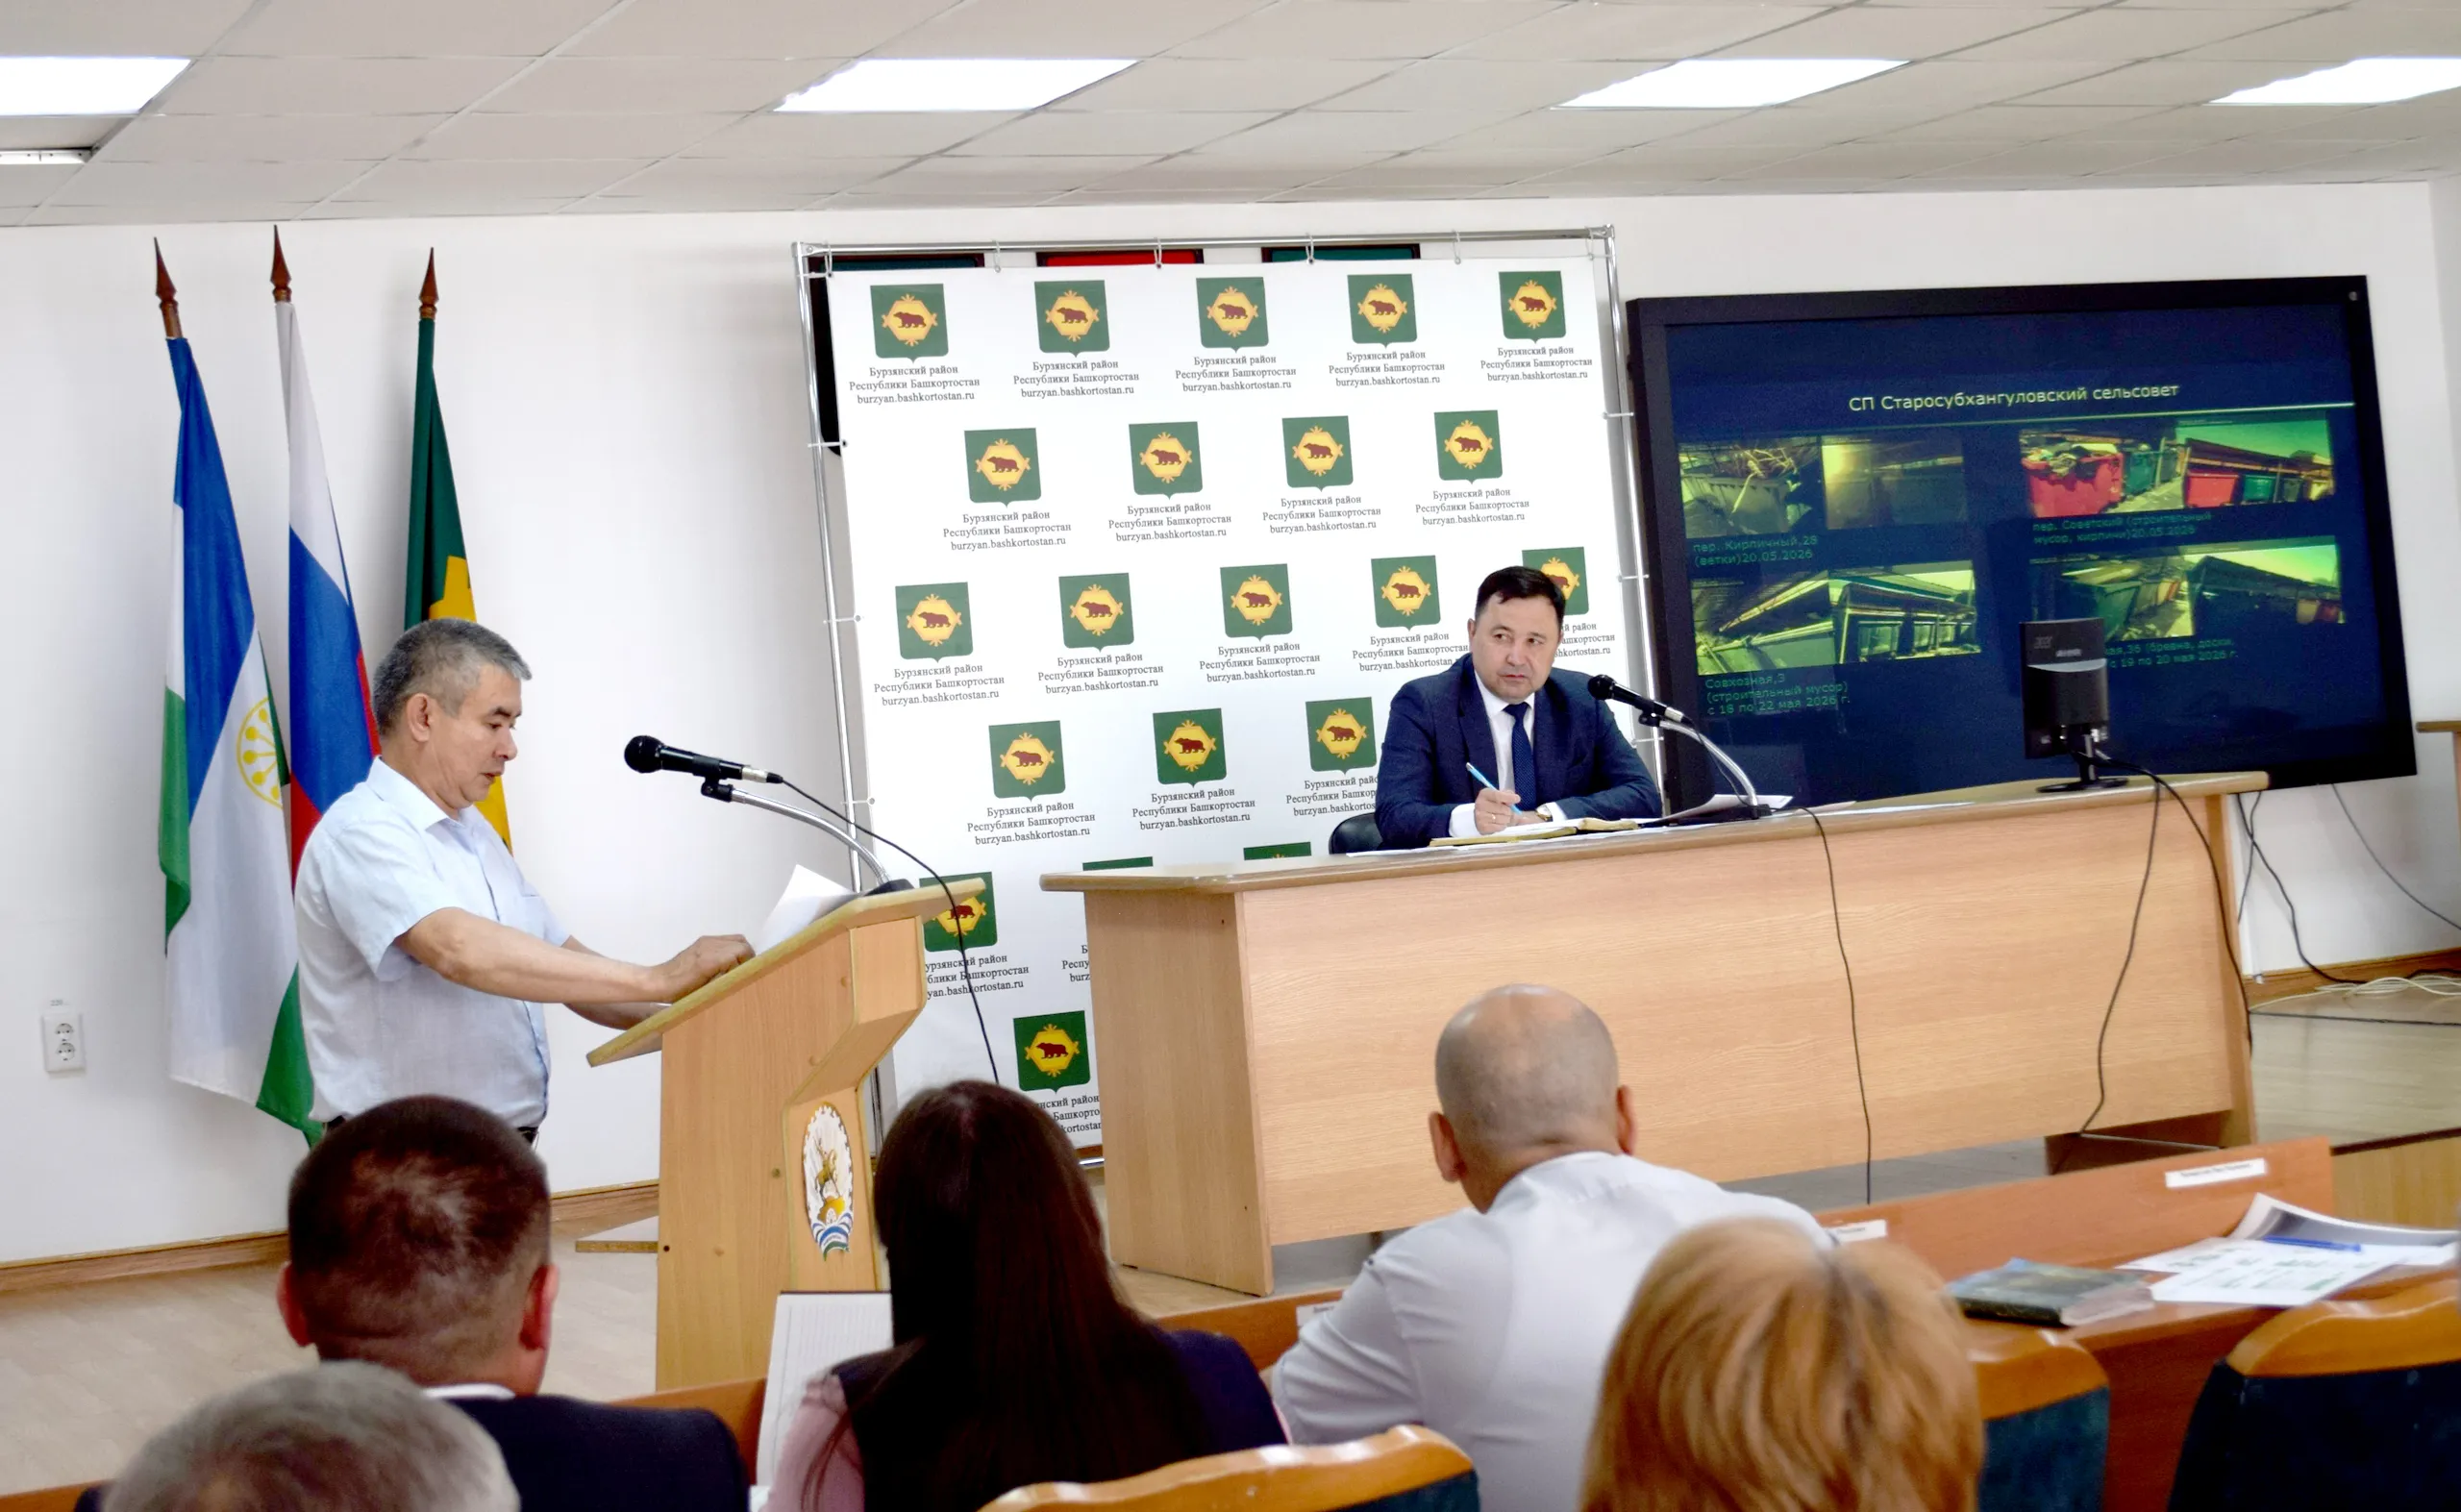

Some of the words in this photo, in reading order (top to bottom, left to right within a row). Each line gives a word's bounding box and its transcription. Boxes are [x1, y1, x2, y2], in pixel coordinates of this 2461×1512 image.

[1346, 352, 1398, 362] Бурзянский
[1400, 351, 1426, 360] район
[1497, 347, 1547, 358] Бурзянский
[1548, 346, 1574, 357] район
[1032, 361, 1088, 372] Бурзянский
[1090, 360, 1119, 371] район
[1193, 357, 1248, 367] Бурзянский
[1249, 356, 1277, 365] район
[1479, 359, 1531, 370] Республики
[1532, 359, 1593, 368] Башкортостан
[869, 366, 927, 378] Бурзянский
[929, 366, 958, 377] район
[1175, 369, 1230, 381] Республики
[1231, 369, 1297, 378] Башкортостан
[1329, 364, 1381, 375] Республики
[1383, 364, 1446, 373] Башкортостан
[1013, 375, 1070, 385] Республики
[1072, 374, 1139, 384] Башкортостан
[1335, 377, 1441, 387] burzyan.bashkortostan.ru
[1486, 371, 1588, 383] burzyan.bashkortostan.ru
[849, 381, 907, 391] Республики
[910, 380, 981, 389] Башкортостан
[1181, 382, 1292, 393] burzyan.bashkortostan.ru
[857, 393, 975, 405] burzyan.bashkortostan.ru
[1020, 387, 1134, 399] burzyan.bashkortostan.ru
[1849, 396, 1875, 411] СП
[1880, 387, 2088, 411] Старосубхангуловский
[2092, 385, 2180, 400] сельсовет
[1432, 490, 1483, 501] Бурзянский
[1484, 489, 1511, 499] район
[1280, 497, 1333, 508] Бурзянский
[1334, 496, 1362, 506] район
[1415, 504, 1467, 513] Республики
[1469, 502, 1529, 510] Башкортостан
[1127, 505, 1181, 516] Бурзянский
[1183, 504, 1211, 513] район
[1262, 511, 1316, 522] Республики
[1318, 509, 1381, 518] Башкортостан
[962, 512, 1019, 525] Бурзянский
[1021, 511, 1051, 522] район
[1108, 519, 1164, 530] Республики
[1166, 517, 1231, 526] Башкортостан
[1422, 514, 1526, 526] burzyan.bashkortostan.ru
[943, 527, 1001, 538] Республики
[1003, 525, 1072, 534] Башкортостан
[1269, 522, 1377, 534] burzyan.bashkortostan.ru
[1115, 530, 1227, 542] burzyan.bashkortostan.ru
[950, 538, 1066, 551] burzyan.bashkortostan.ru
[1572, 623, 1597, 633] район
[1370, 634, 1422, 647] Бурзянский
[1424, 632, 1450, 644] район
[1562, 634, 1616, 645] ашкортостан
[1217, 644, 1271, 657] Бурзянский
[1273, 643, 1301, 654] район
[1352, 647, 1405, 659] Республики
[1406, 644, 1469, 656] Башкортостан
[1056, 655, 1112, 668] Бурзянский
[1114, 654, 1143, 664] район
[1199, 658, 1255, 670] Республики
[1255, 656, 1321, 666] Башкортостан
[1359, 657, 1457, 673] burzyan.bashkortostan.
[893, 666, 952, 680] Бурзянский
[954, 664, 983, 676] район
[1037, 670, 1095, 682] Республики
[1097, 666, 1164, 677] Башкортостан
[1206, 669, 1316, 682] burzyan.bashkortostan.ru
[873, 682, 932, 693] Республики
[934, 678, 1005, 688] Башкортостан
[1045, 680, 1159, 694] burzyan.bashkortostan.ru
[882, 691, 1000, 706] burzyan.bashkortostan.ru
[1706, 686, 1802, 704] (строительный
[1805, 682, 1849, 695] мусор)
[1706, 706, 1715, 715] с
[1720, 705, 1734, 714] 18
[1738, 704, 1754, 713] по
[1758, 701, 1775, 711] 22
[1777, 699, 1801, 708] мая
[1805, 695, 1837, 707] 2026
[1305, 777, 1356, 791] Бурзянский
[1151, 790, 1206, 804] Бурзянский
[1206, 788, 1235, 800] район
[1286, 792, 1339, 805] Республики
[1342, 789, 1377, 800] Башкор
[986, 804, 1044, 818] Бурзянский
[1045, 803, 1075, 813] район
[1131, 806, 1188, 818] Республики
[1189, 801, 1255, 812] Башкортостан
[1293, 803, 1376, 817] burzyan.bashkortos
[967, 820, 1025, 832] Республики
[1027, 814, 1096, 827] Башкортостан
[1139, 814, 1251, 830] burzyan.bashkortostan.ru
[974, 829, 1091, 845] burzyan.bashkortostan.ru
[925, 956, 976, 973] урзянский
[978, 954, 1007, 967] район
[1061, 959, 1089, 970] Респу
[927, 974, 957, 984] блики
[1038, 1098, 1069, 1109] нский
[1071, 1095, 1100, 1107] район
[1053, 1108, 1101, 1122] Башкорто
